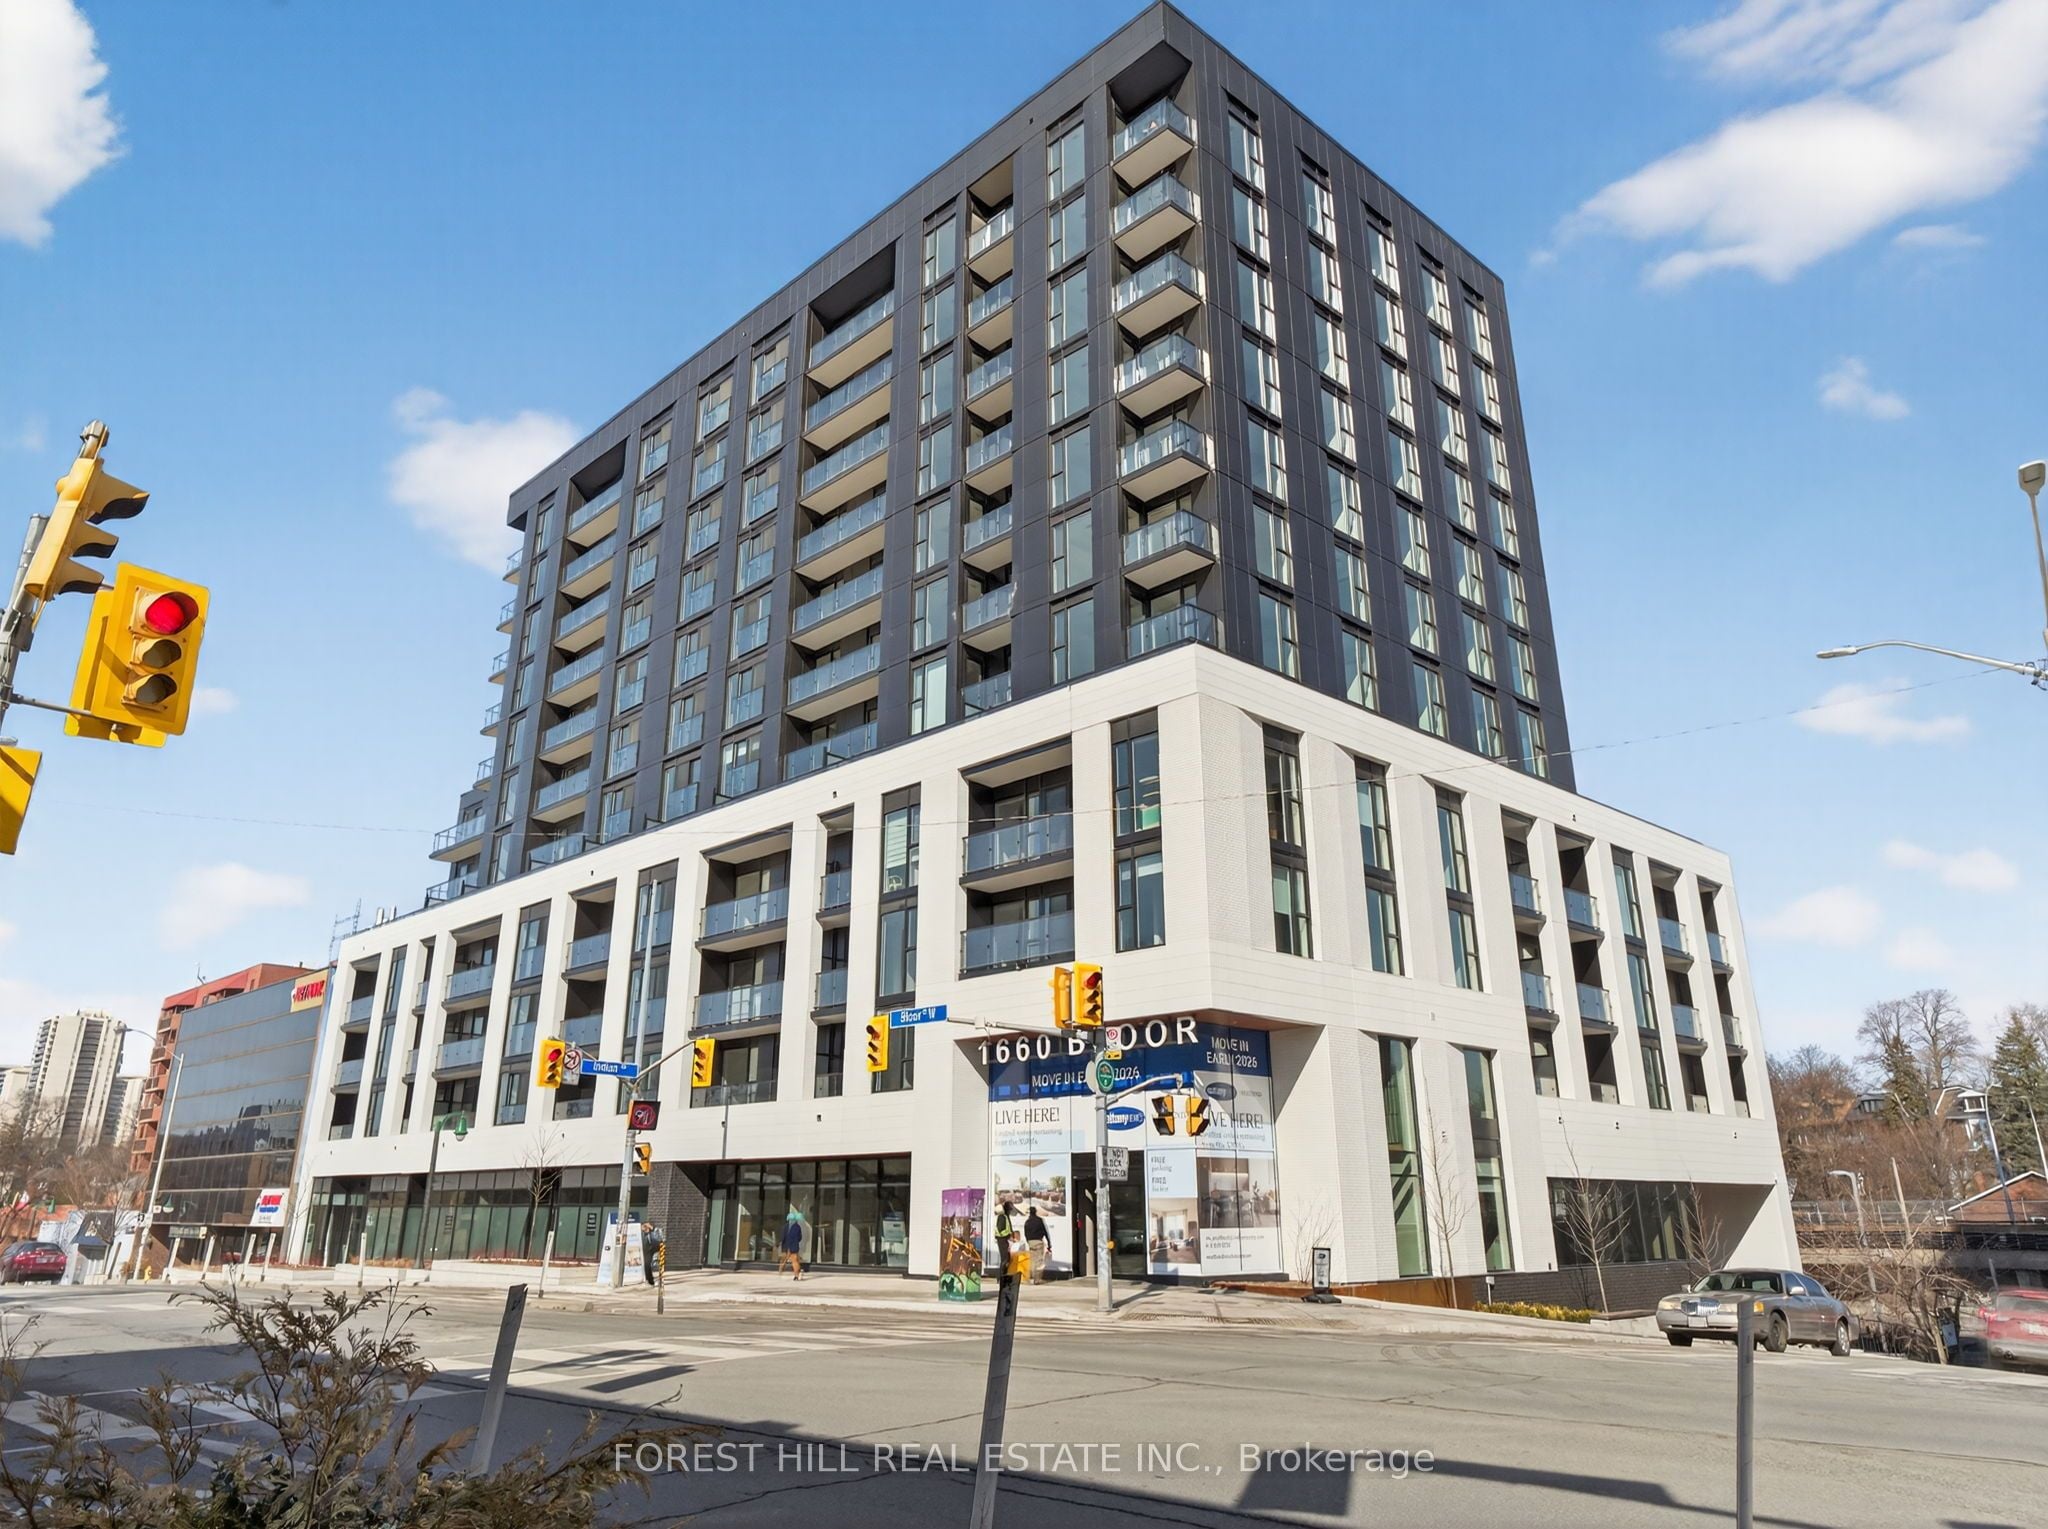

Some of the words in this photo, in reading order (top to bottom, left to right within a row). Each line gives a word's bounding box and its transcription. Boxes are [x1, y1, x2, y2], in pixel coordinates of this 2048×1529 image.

[901, 1010, 921, 1023] Bloor
[978, 1034, 1051, 1066] 1660
[1068, 1016, 1199, 1056] BOOR
[593, 1061, 618, 1073] Indian
[1235, 1056, 1257, 1068] 2026
[1032, 1072, 1062, 1087] MOVE
[1064, 1072, 1075, 1085] IN
[1114, 1066, 1141, 1081] 2026
[995, 1110, 1021, 1125] LIVE
[1024, 1107, 1060, 1123] HERE!
[1230, 1111, 1263, 1129] HERE!
